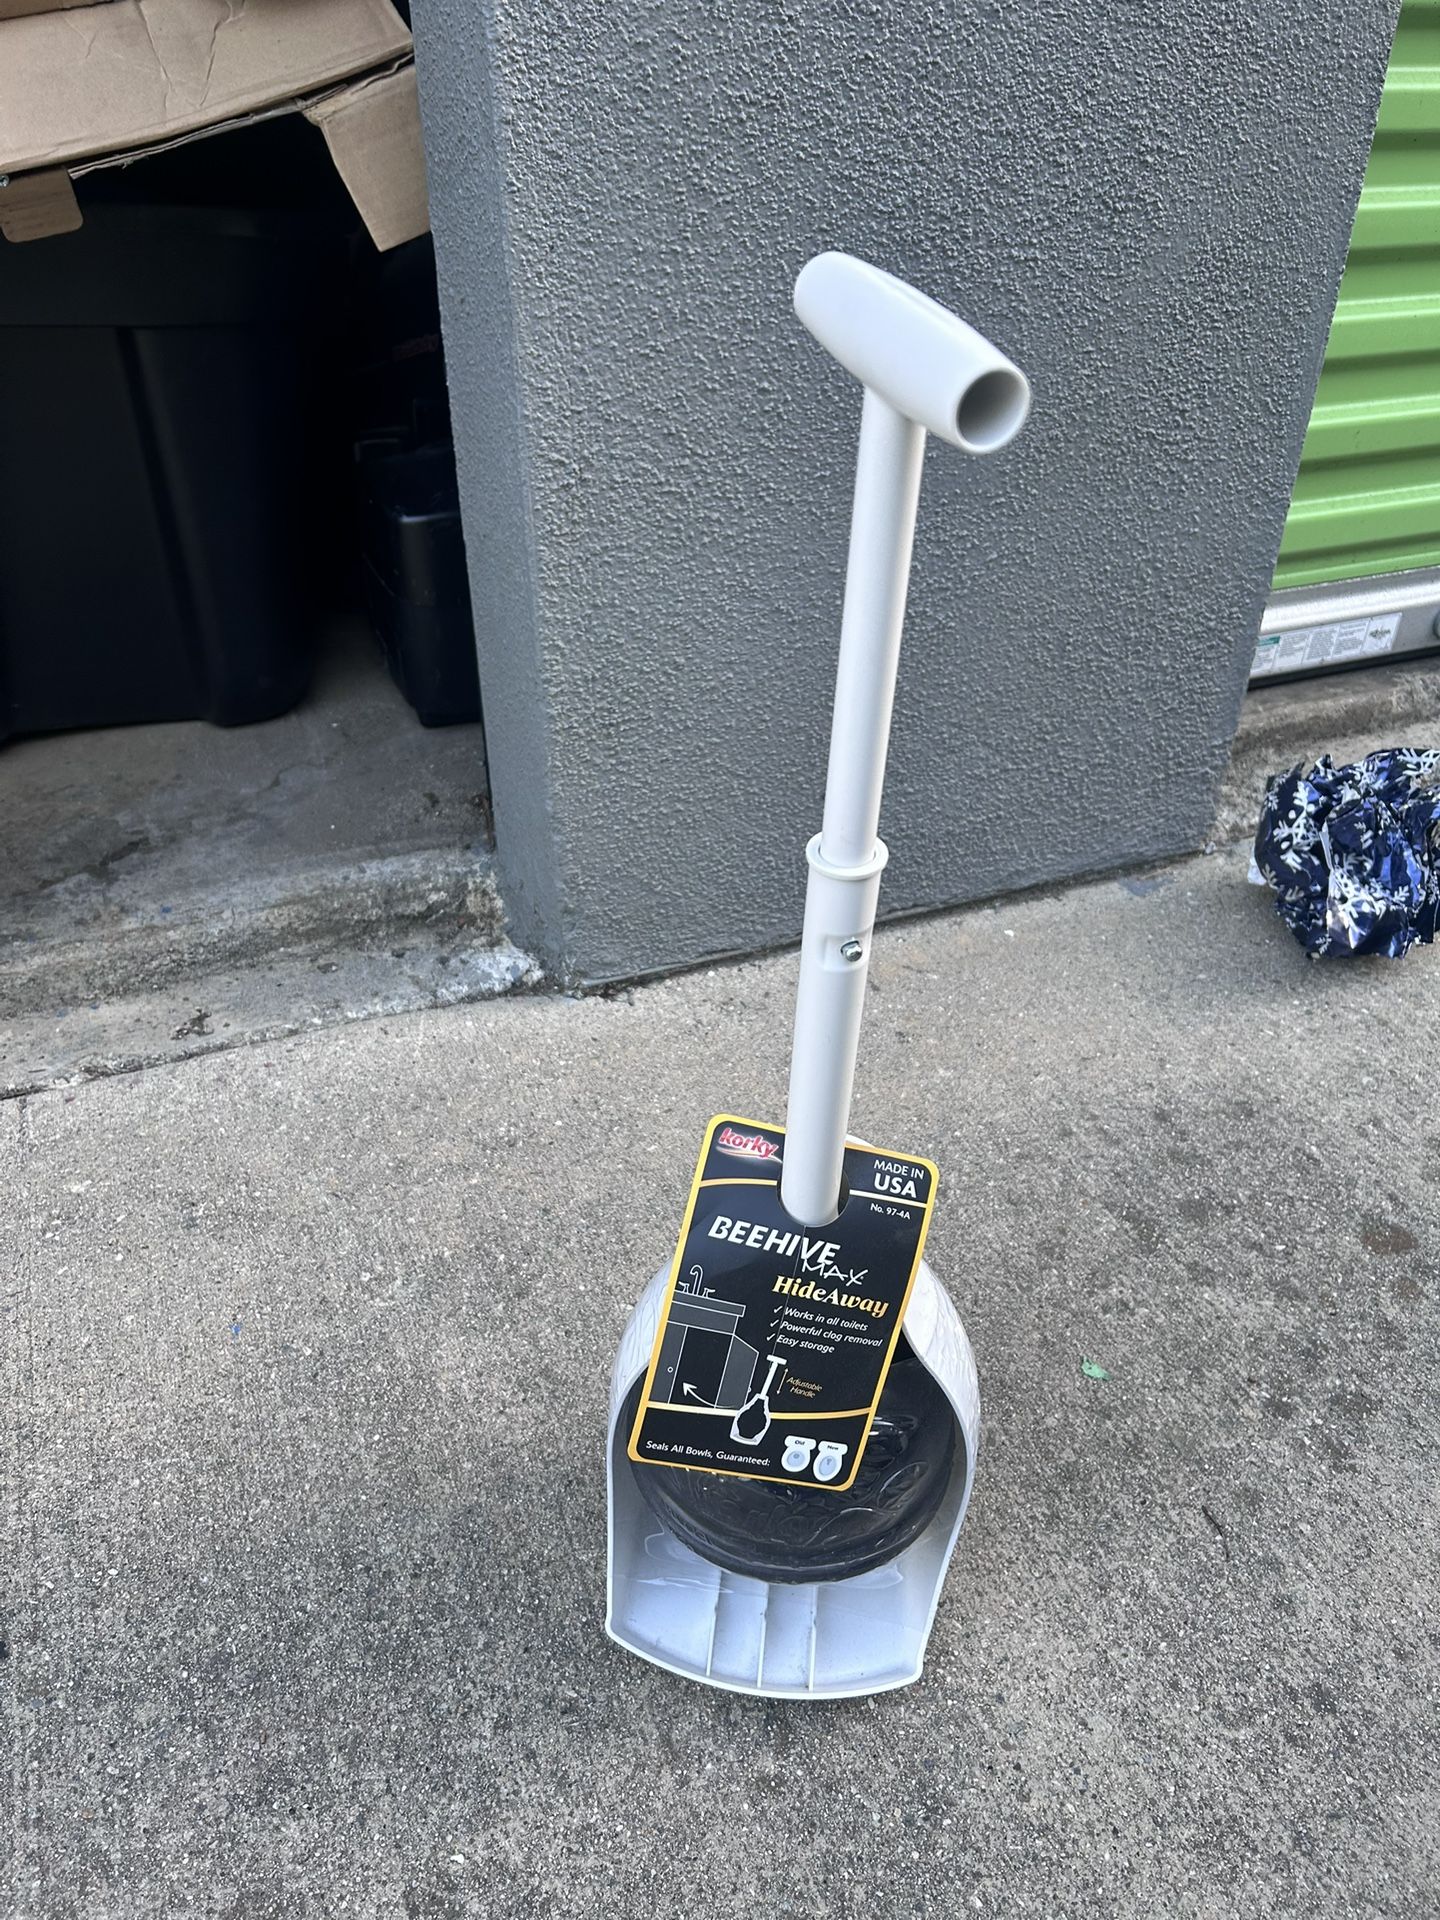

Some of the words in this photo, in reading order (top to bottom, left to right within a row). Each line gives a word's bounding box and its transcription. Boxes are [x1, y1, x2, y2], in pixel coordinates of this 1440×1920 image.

[719, 1127, 779, 1159] korky
[874, 1160, 909, 1176] MADE
[911, 1168, 924, 1180] IN
[874, 1173, 917, 1198] USA
[870, 1203, 884, 1213] No.
[886, 1207, 911, 1220] 97-4A
[708, 1216, 841, 1265] BEEHIVE
[802, 1259, 868, 1286] MAX
[772, 1275, 889, 1318] HideAway
[785, 1307, 814, 1321] Works
[815, 1314, 825, 1323] in
[827, 1317, 840, 1326] all
[840, 1320, 868, 1331] toilets
[777, 1334, 799, 1347] Easy
[800, 1341, 835, 1353] storage
[780, 1321, 822, 1336] Powerful
[823, 1331, 843, 1342] clog
[844, 1335, 883, 1347] removal
[786, 1376, 823, 1392] Adjustable
[790, 1386, 816, 1398] Handle
[645, 1440, 669, 1451] Seals
[670, 1444, 684, 1453] All
[685, 1447, 713, 1459] Bowls,
[716, 1451, 771, 1466] Guaranteed:
